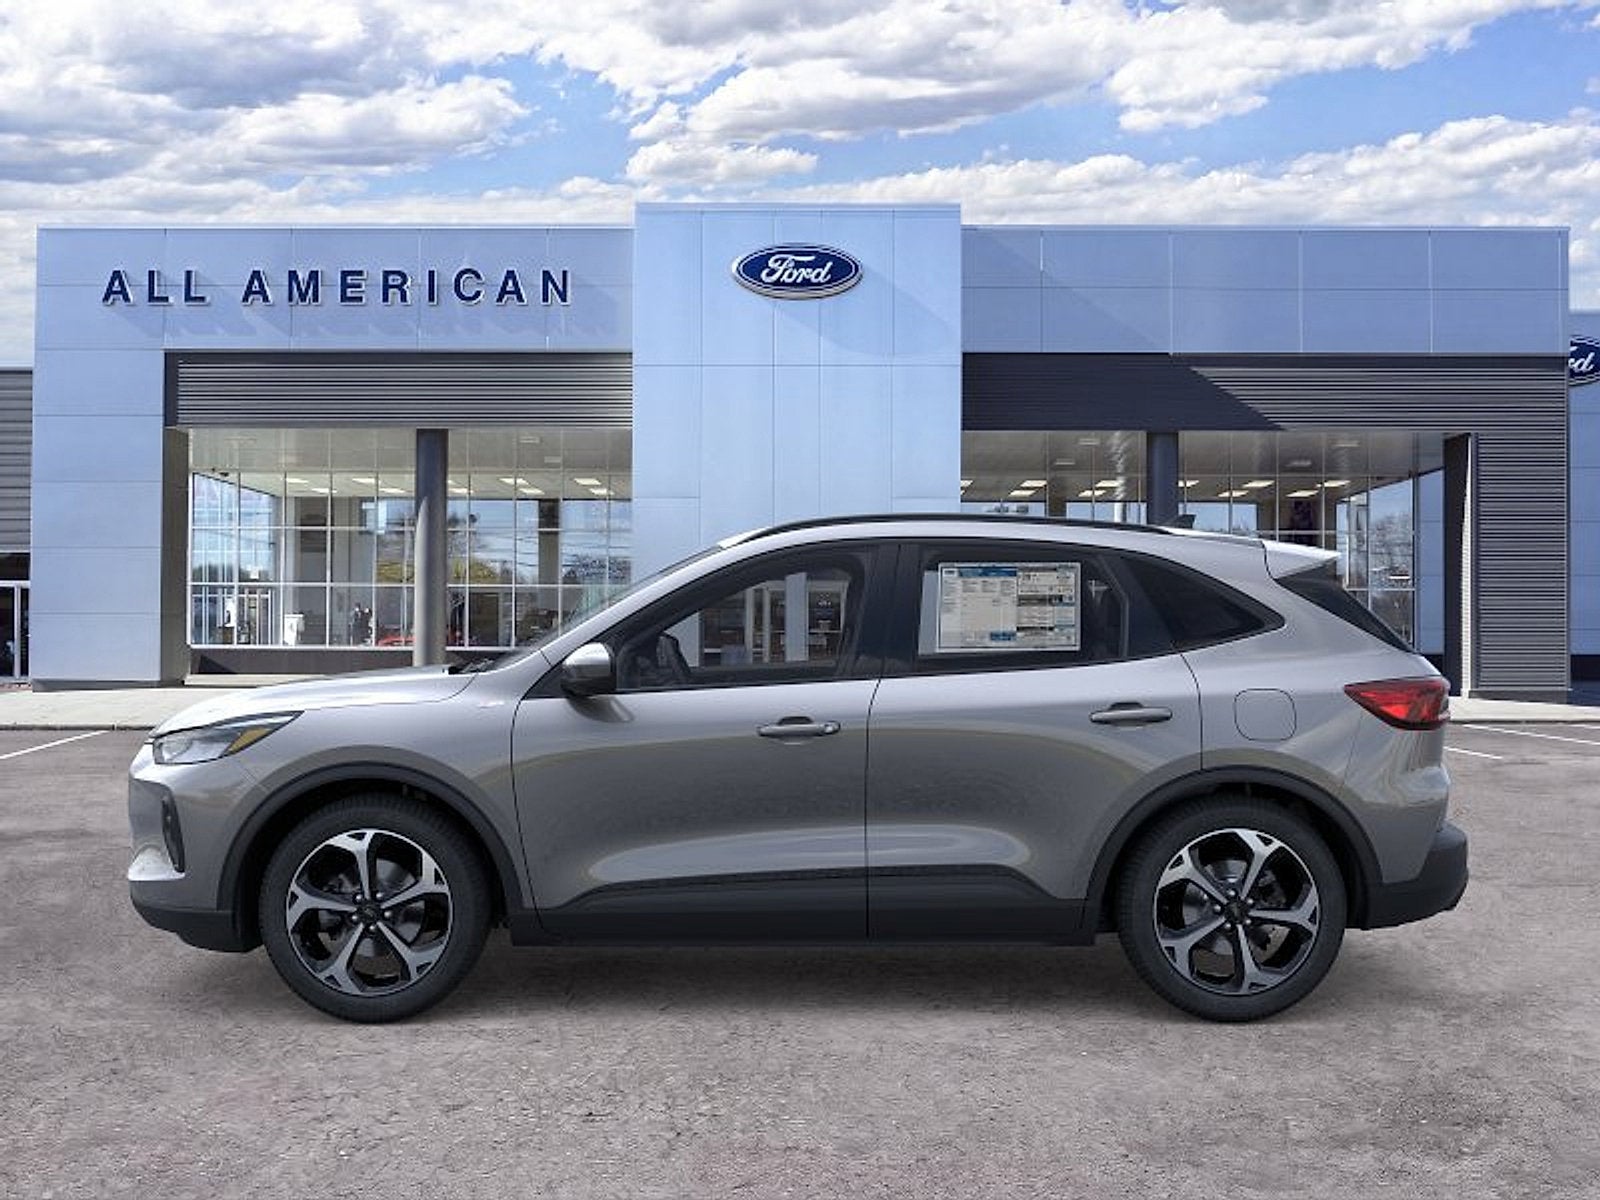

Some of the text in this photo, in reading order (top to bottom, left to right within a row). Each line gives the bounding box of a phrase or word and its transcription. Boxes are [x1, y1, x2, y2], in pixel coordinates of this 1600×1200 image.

[760, 254, 833, 283] Ford
[102, 268, 572, 304] ALL AMERICAN
